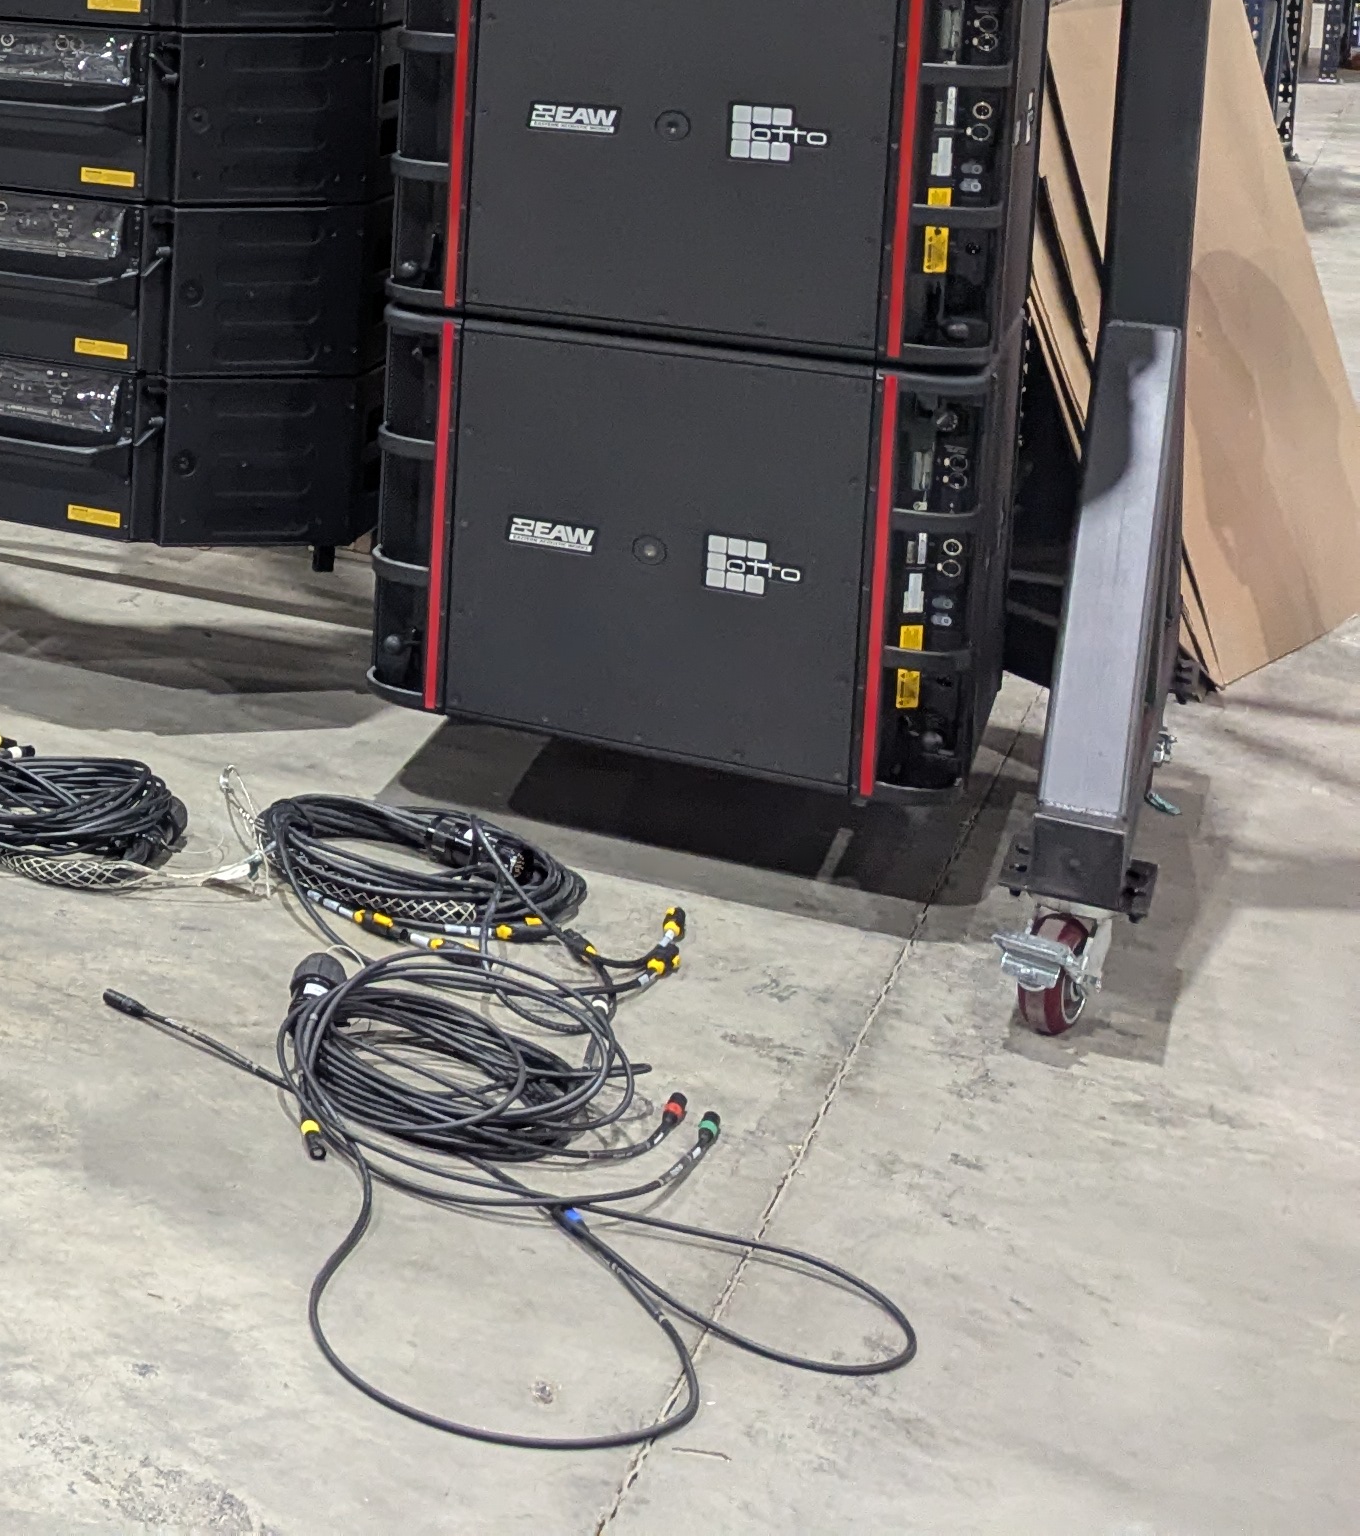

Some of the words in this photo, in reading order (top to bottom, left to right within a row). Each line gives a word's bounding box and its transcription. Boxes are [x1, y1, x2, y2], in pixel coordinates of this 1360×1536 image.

[554, 106, 618, 126] EAW
[751, 126, 828, 146] otto
[534, 521, 595, 545] EAW
[726, 558, 801, 582] otto
